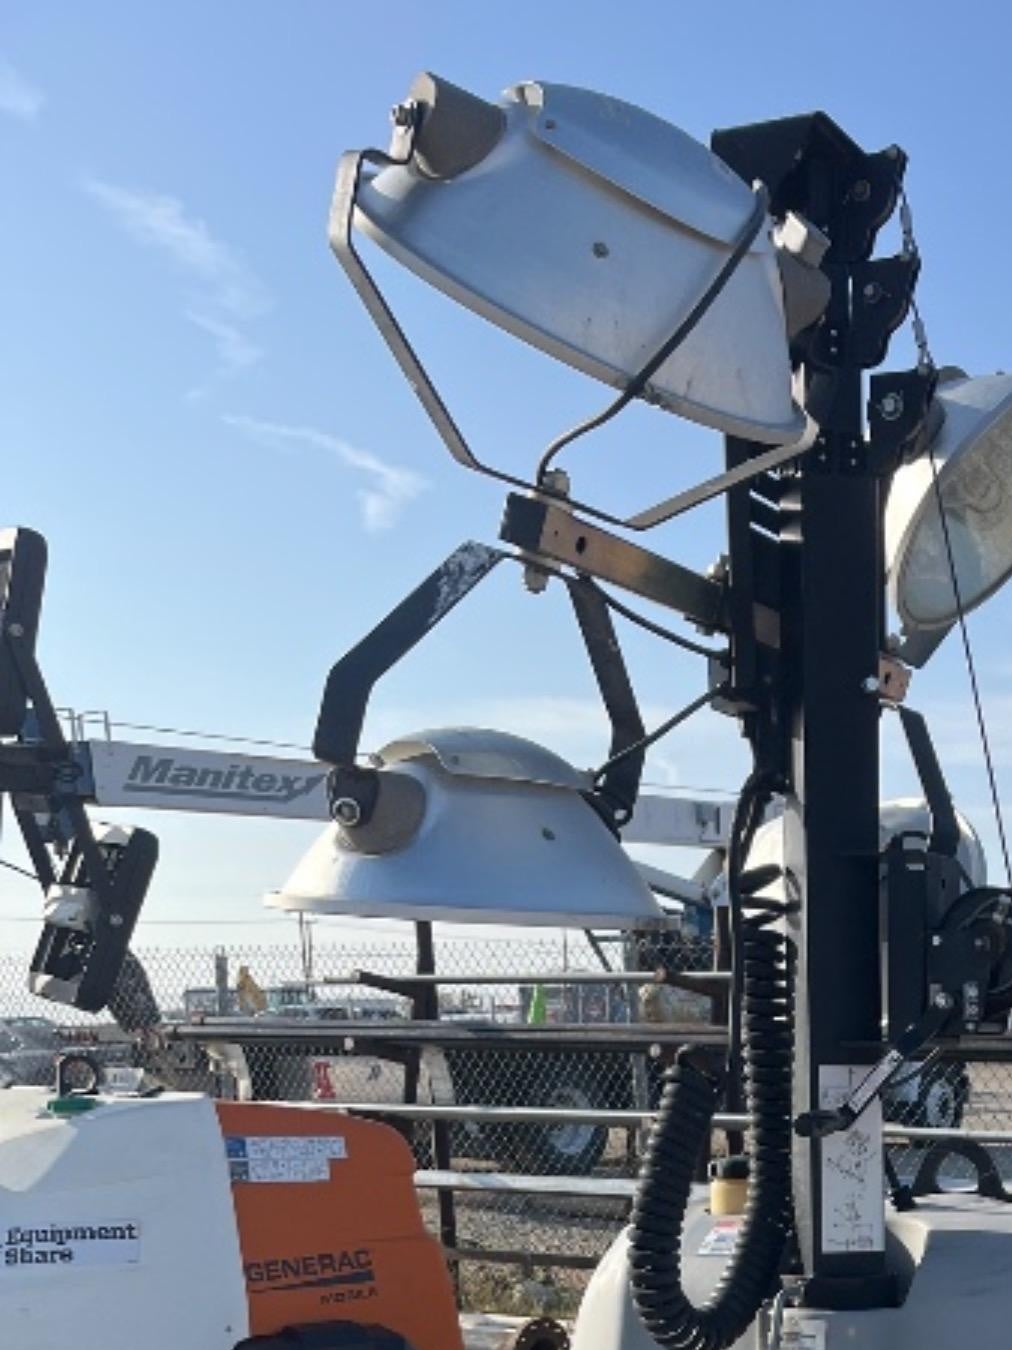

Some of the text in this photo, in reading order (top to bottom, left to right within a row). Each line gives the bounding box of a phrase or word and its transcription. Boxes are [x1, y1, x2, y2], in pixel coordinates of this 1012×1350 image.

[128, 755, 305, 794] Manitex
[5, 1224, 138, 1248] Equipment
[5, 1248, 74, 1265] Share
[243, 1249, 373, 1281] GENERAC
